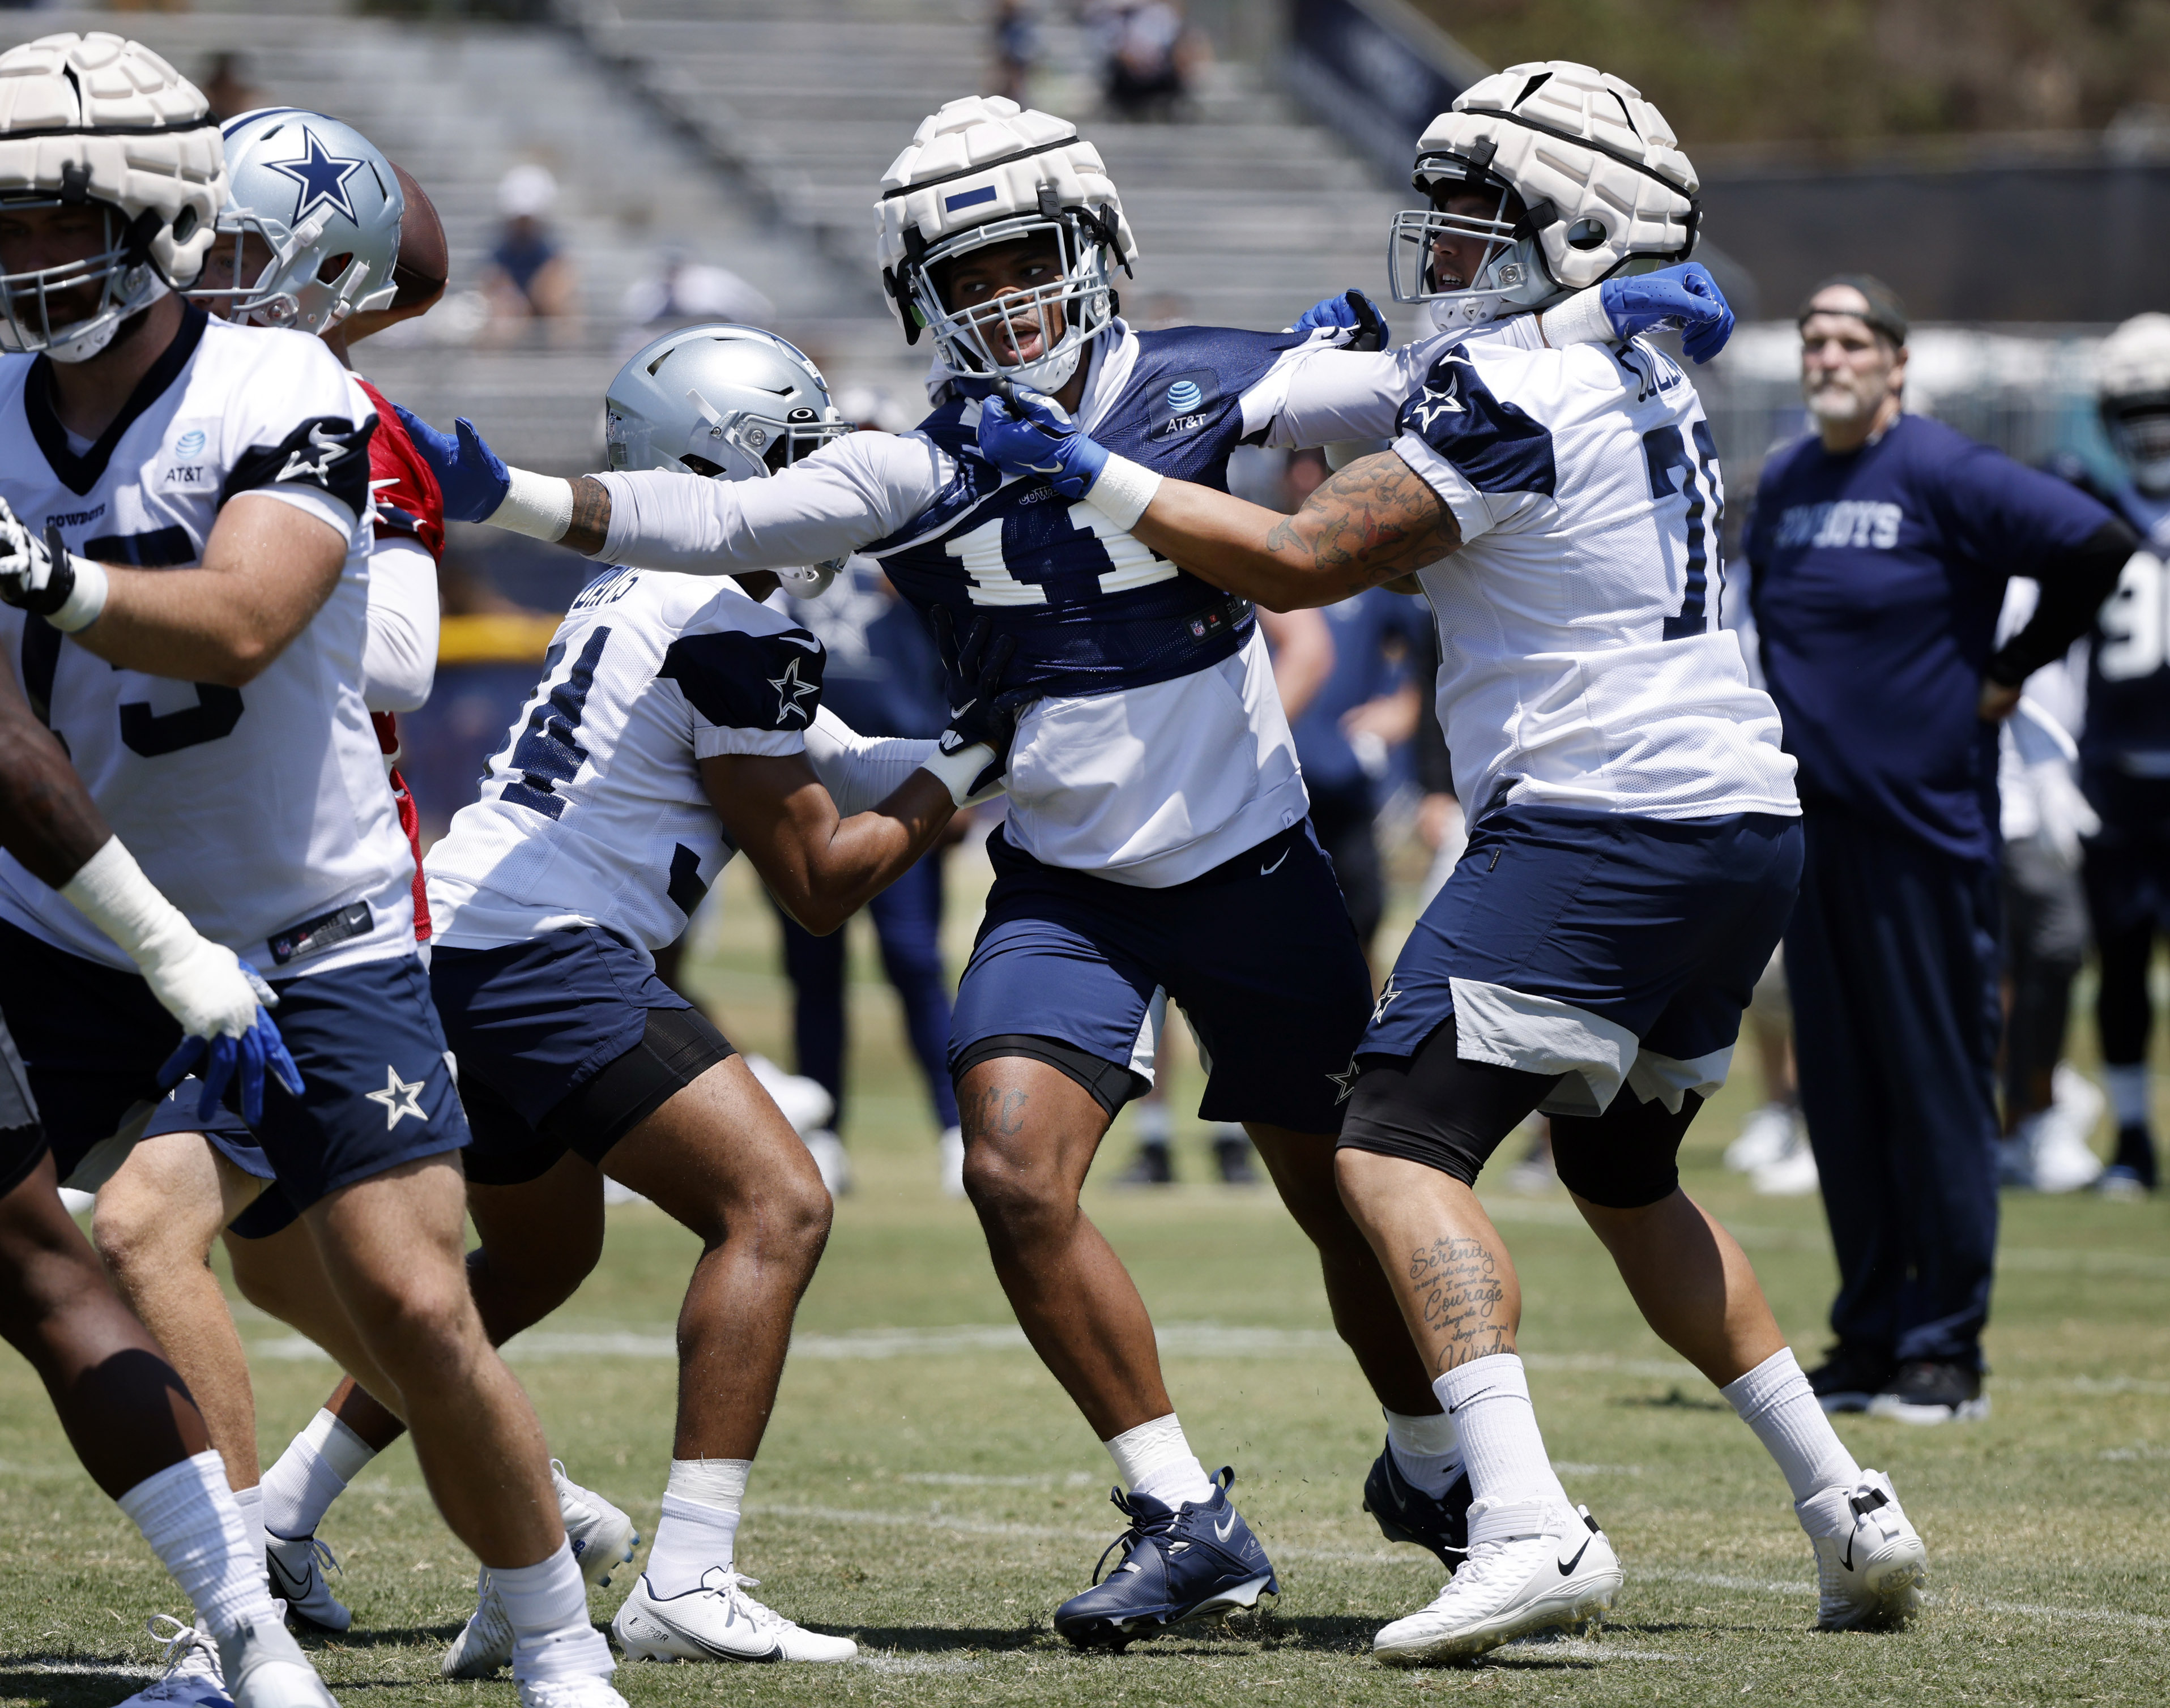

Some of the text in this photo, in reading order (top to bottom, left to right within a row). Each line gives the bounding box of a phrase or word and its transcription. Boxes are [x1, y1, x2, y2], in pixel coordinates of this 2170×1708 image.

[1166, 413, 1206, 433] AT&T
[165, 467, 203, 482] AT&T
[945, 501, 1178, 606] 11
[1410, 1244, 1495, 1279] Serenity
[1446, 1280, 1454, 1292] I
[1425, 1288, 1503, 1322] Courage
[1478, 1321, 1487, 1333] I
